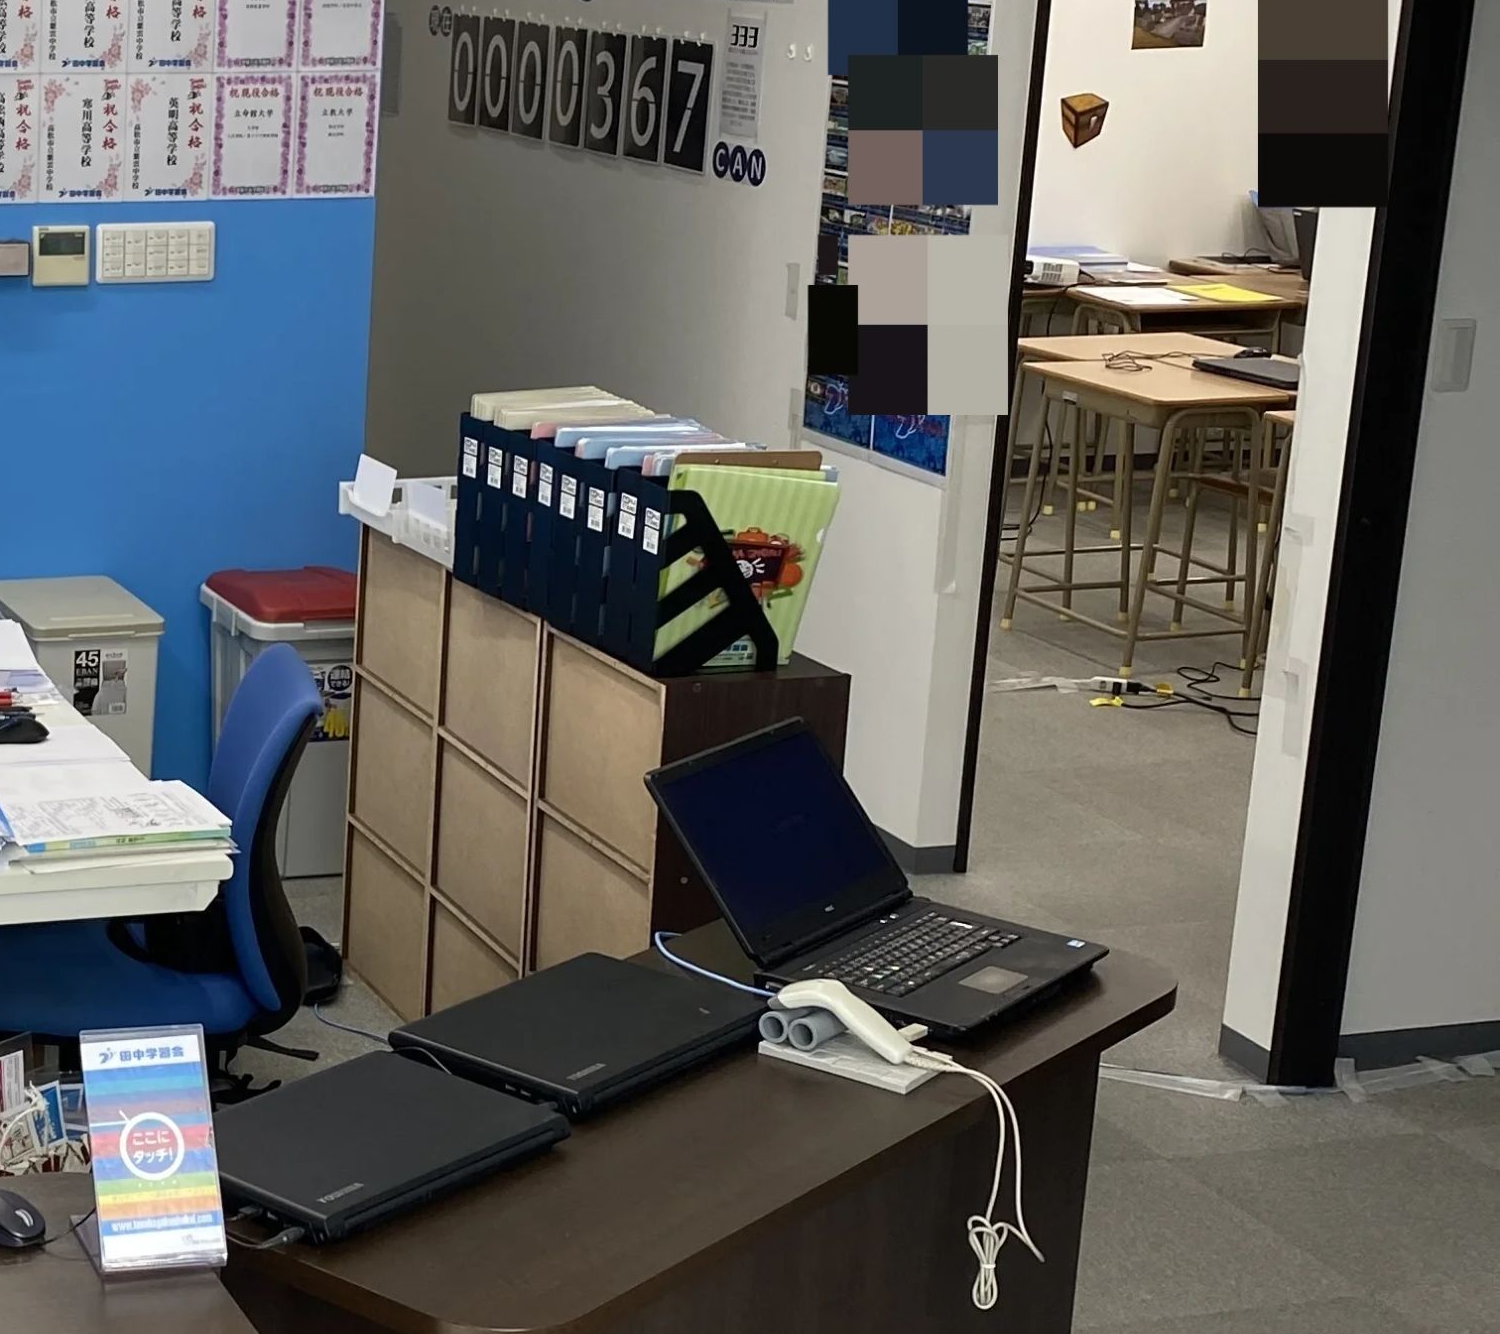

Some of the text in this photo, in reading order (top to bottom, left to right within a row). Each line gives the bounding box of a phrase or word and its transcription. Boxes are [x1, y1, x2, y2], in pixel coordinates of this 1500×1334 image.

[453, 31, 705, 153] 0000367
[16, 104, 31, 150] 祝合格
[81, 98, 92, 167] 寒川高等学校
[103, 104, 117, 150] 祝合格
[167, 98, 178, 165] 英明高等学校
[188, 103, 203, 148] 祝合格
[715, 148, 764, 181] CAN
[76, 651, 99, 667] 45
[119, 1046, 184, 1062] 田中学習会
[132, 1130, 171, 1146] ここに
[133, 1147, 174, 1165] タッチ!
